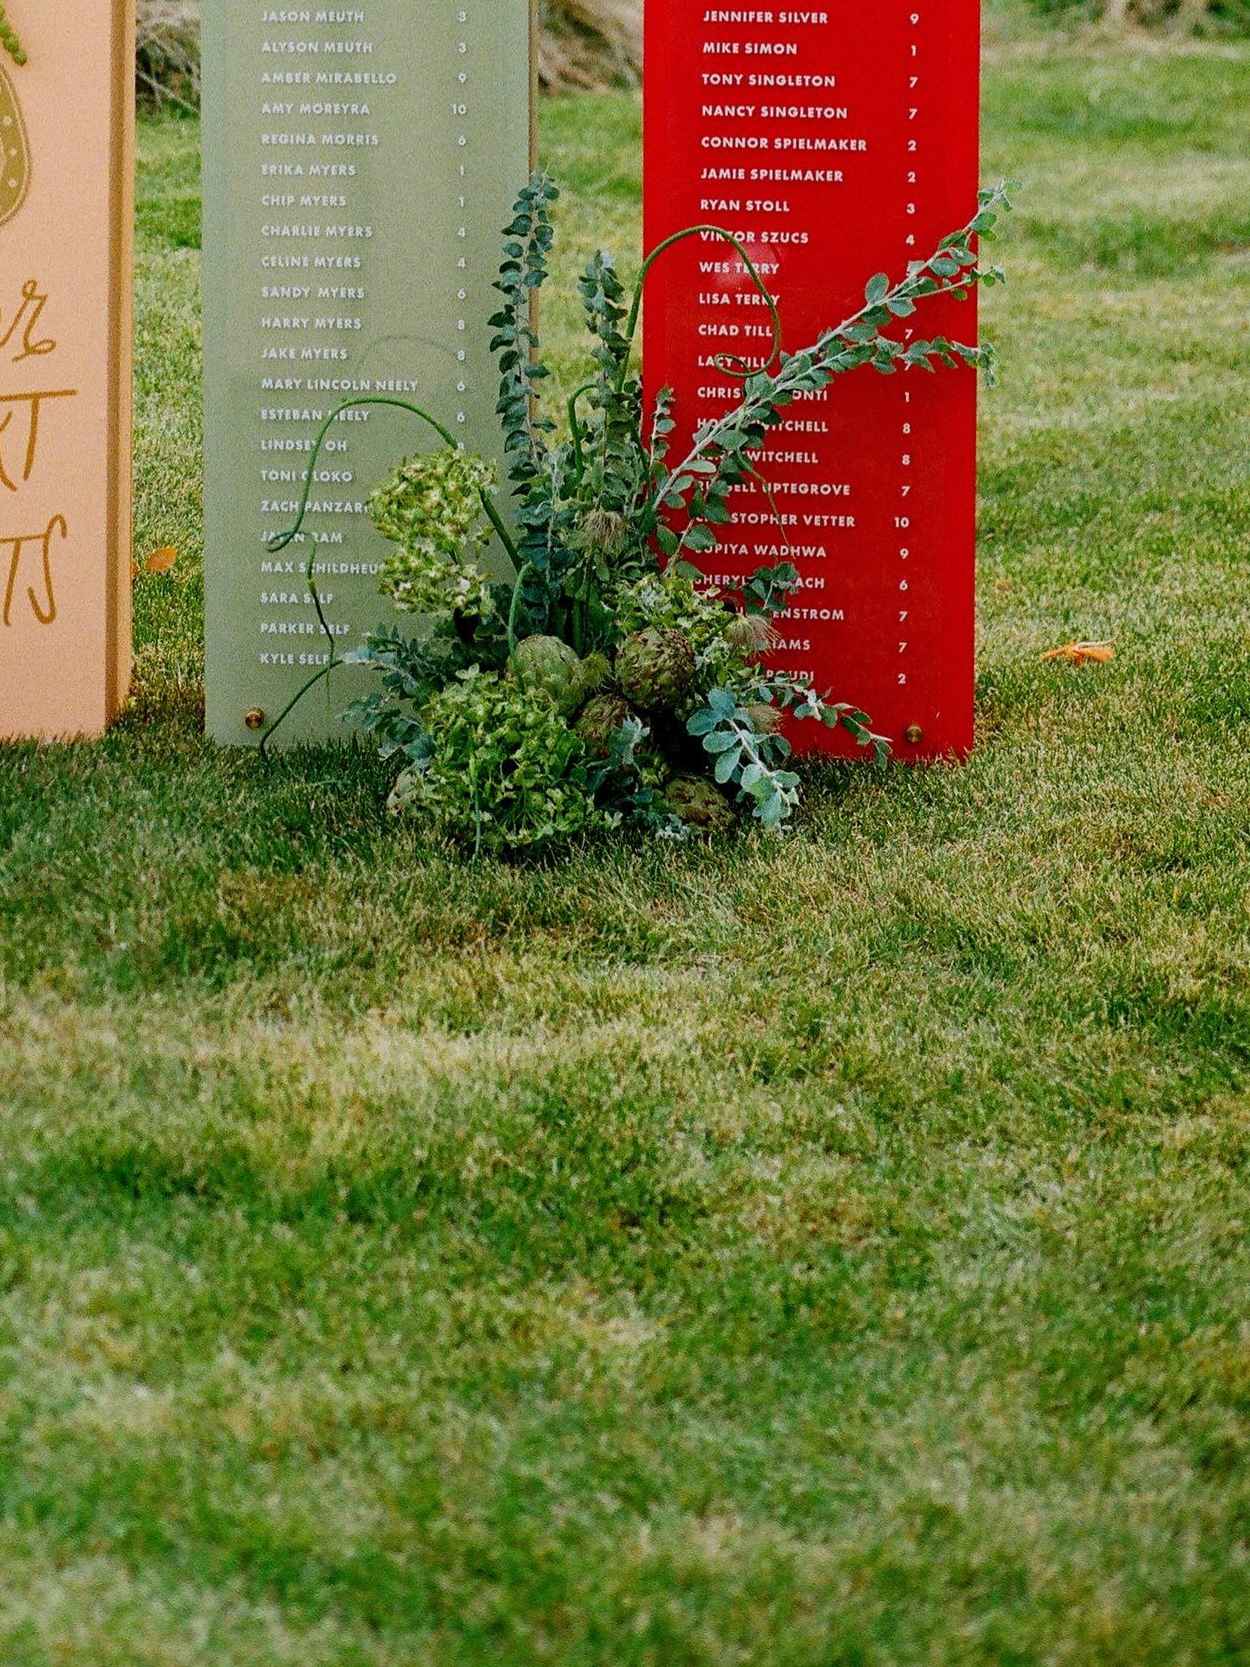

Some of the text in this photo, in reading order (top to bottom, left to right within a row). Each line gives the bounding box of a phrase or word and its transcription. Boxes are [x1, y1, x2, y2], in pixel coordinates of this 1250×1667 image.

[260, 9, 467, 23] JASON MEUTH 3
[702, 9, 920, 25] JENNIFER SILVER 9
[702, 41, 917, 57] MIKE SIMON 1
[261, 71, 468, 85] AMBER MIRABELLO 9
[701, 72, 919, 89] TONY SINGLETON 7
[261, 102, 467, 115] AMY MOREYRA 10
[701, 104, 918, 120] NANCY SINGLETON 7
[700, 135, 917, 152] CONNOR SPIELMAKER 2
[700, 167, 917, 184] JAMIE SPIELMAKER 2
[260, 194, 465, 207] CHIP MYERS 1
[700, 198, 916, 215] RYAN STOLL 3
[760, 230, 915, 246] SZUCS 4
[699, 261, 730, 273] WES
[260, 285, 467, 300] SANDY MYERS 6
[698, 293, 731, 305] LISA
[698, 324, 914, 340] CHAD TILL 7
[260, 345, 466, 361] JAKE MYERS 8
[260, 376, 468, 392] MARY LINCOLN NEELY 6
[904, 392, 911, 403] 1
[902, 423, 911, 435] 8
[901, 454, 911, 466] 8
[260, 469, 296, 482] TONI
[762, 483, 911, 498] UPTEGROVE 7
[802, 514, 910, 529] VETTER 10
[753, 544, 910, 560] WADHWA 9
[260, 561, 294, 573] MAX
[899, 579, 909, 591] 6
[260, 592, 299, 604] SARA
[898, 611, 909, 623] 7
[260, 622, 315, 635] PARKER
[898, 642, 908, 654] 7
[260, 653, 295, 665] KYLE
[897, 673, 907, 685] 2
